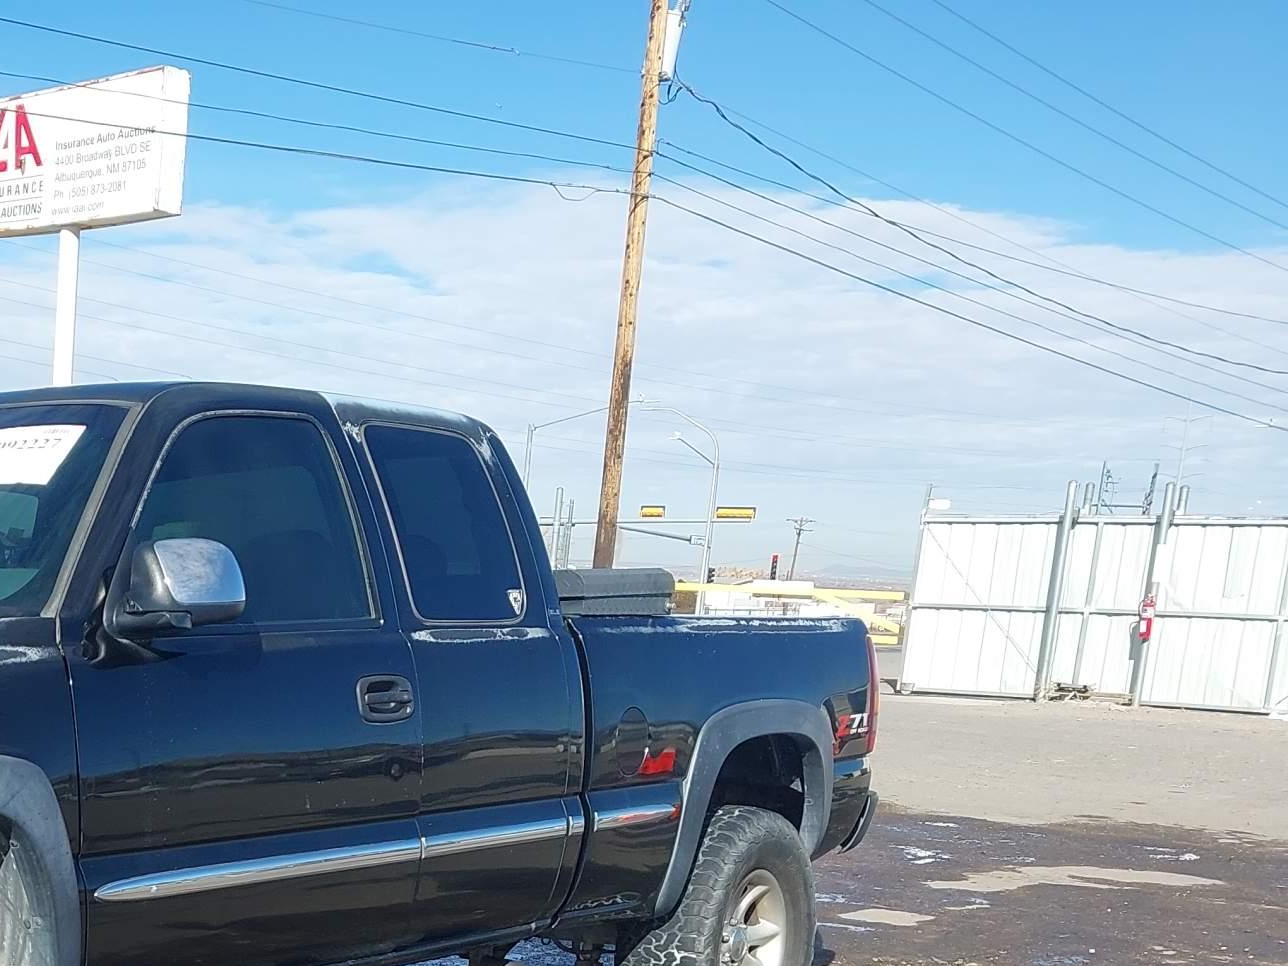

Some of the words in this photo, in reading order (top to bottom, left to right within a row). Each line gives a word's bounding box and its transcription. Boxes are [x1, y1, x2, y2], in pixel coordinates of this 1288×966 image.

[55, 136, 95, 151] Insurance
[96, 132, 116, 144] Auto
[55, 154, 74, 166] 4400
[75, 148, 113, 164] Broadway
[115, 142, 137, 157] BLVD
[139, 140, 152, 153] SE
[106, 163, 120, 175] NM
[0, 201, 43, 218] AUCTIONS
[836, 712, 870, 737] Z71
